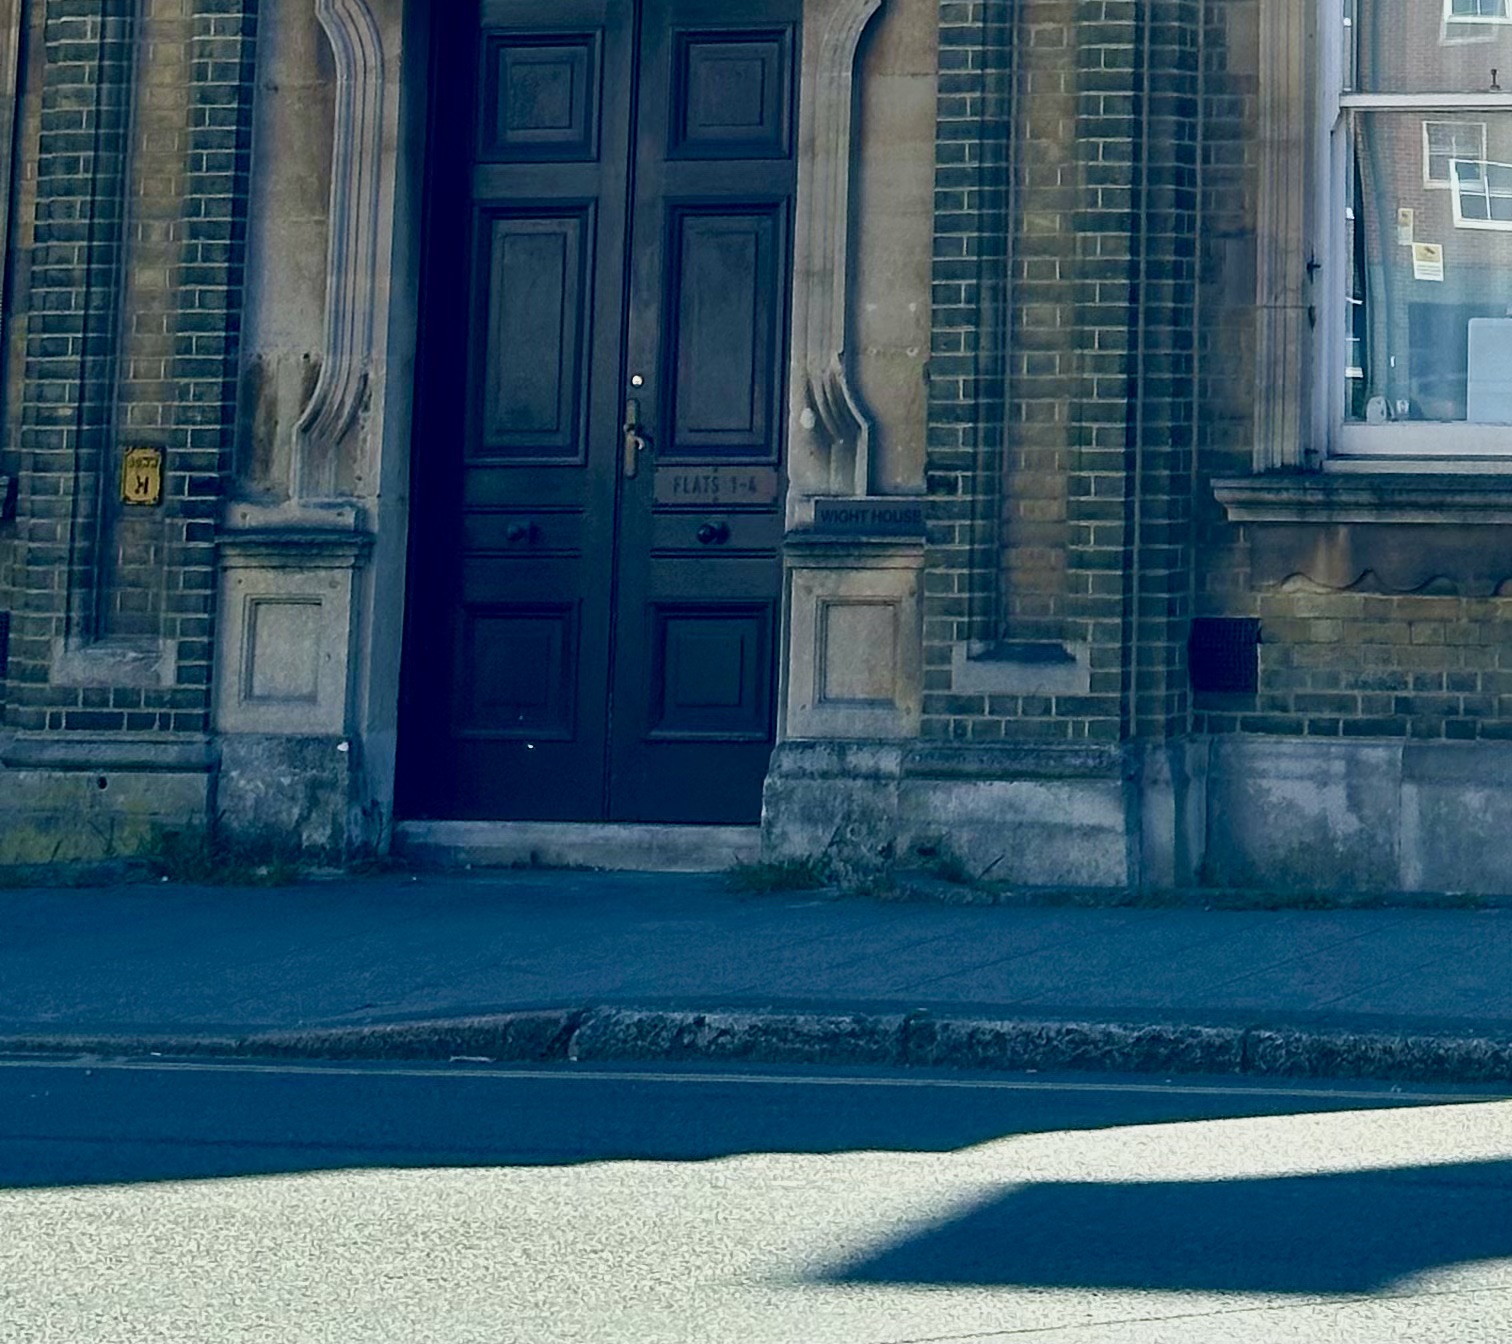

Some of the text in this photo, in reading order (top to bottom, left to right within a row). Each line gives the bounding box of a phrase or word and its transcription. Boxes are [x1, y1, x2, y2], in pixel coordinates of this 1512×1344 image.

[672, 475, 758, 495] FLATS 1-4
[821, 508, 922, 524] WIGHT HOUSE
